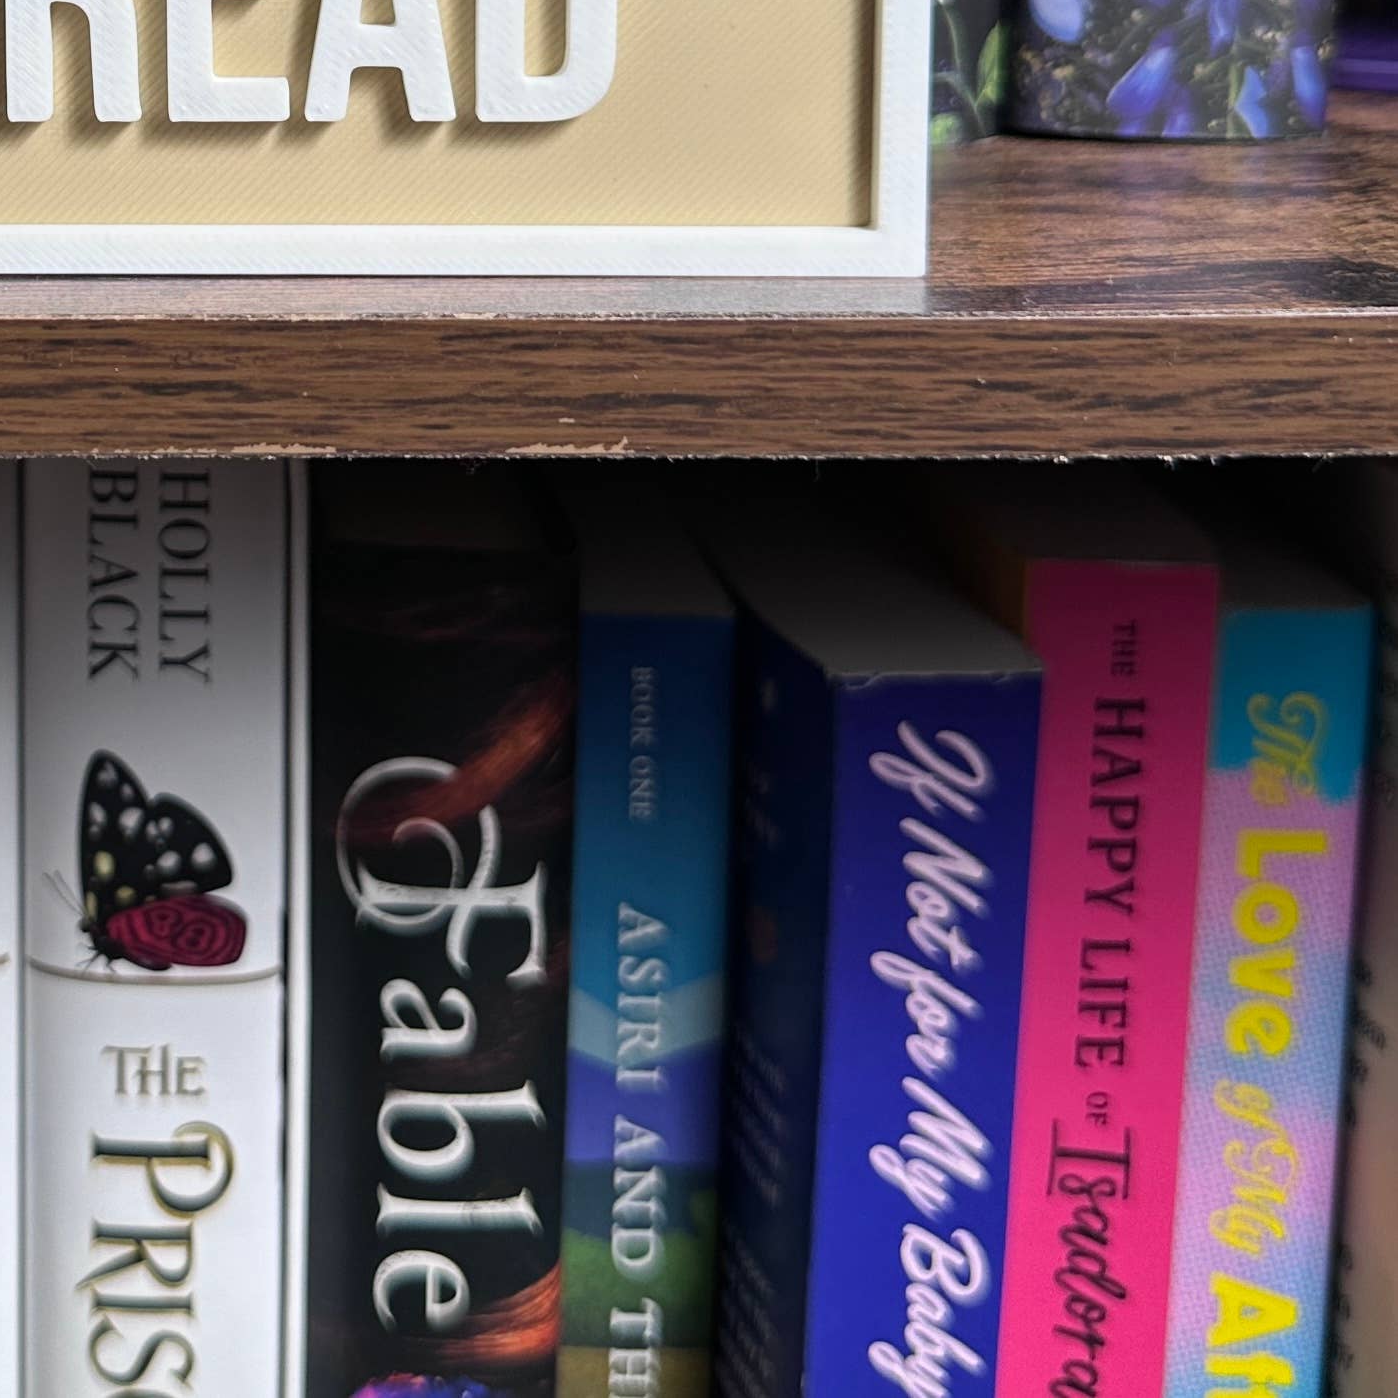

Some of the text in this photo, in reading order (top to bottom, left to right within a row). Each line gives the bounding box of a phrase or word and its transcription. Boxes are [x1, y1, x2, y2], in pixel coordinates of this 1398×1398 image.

[87, 467, 141, 679] BLACK
[158, 469, 210, 683] HOLLY
[627, 665, 658, 822] BOOK ONE
[1247, 691, 1328, 805] The
[336, 755, 549, 1335] Fable
[1046, 619, 1147, 1398] THE HAPPY LIFE OF Isadora
[1224, 826, 1330, 1058] Love
[102, 1043, 208, 1096] THE
[608, 901, 670, 1398] ASIRI AND TH
[866, 719, 995, 1398] If Not for My Baby
[76, 1120, 234, 1398] PRIS
[1204, 1270, 1300, 1398] Af
